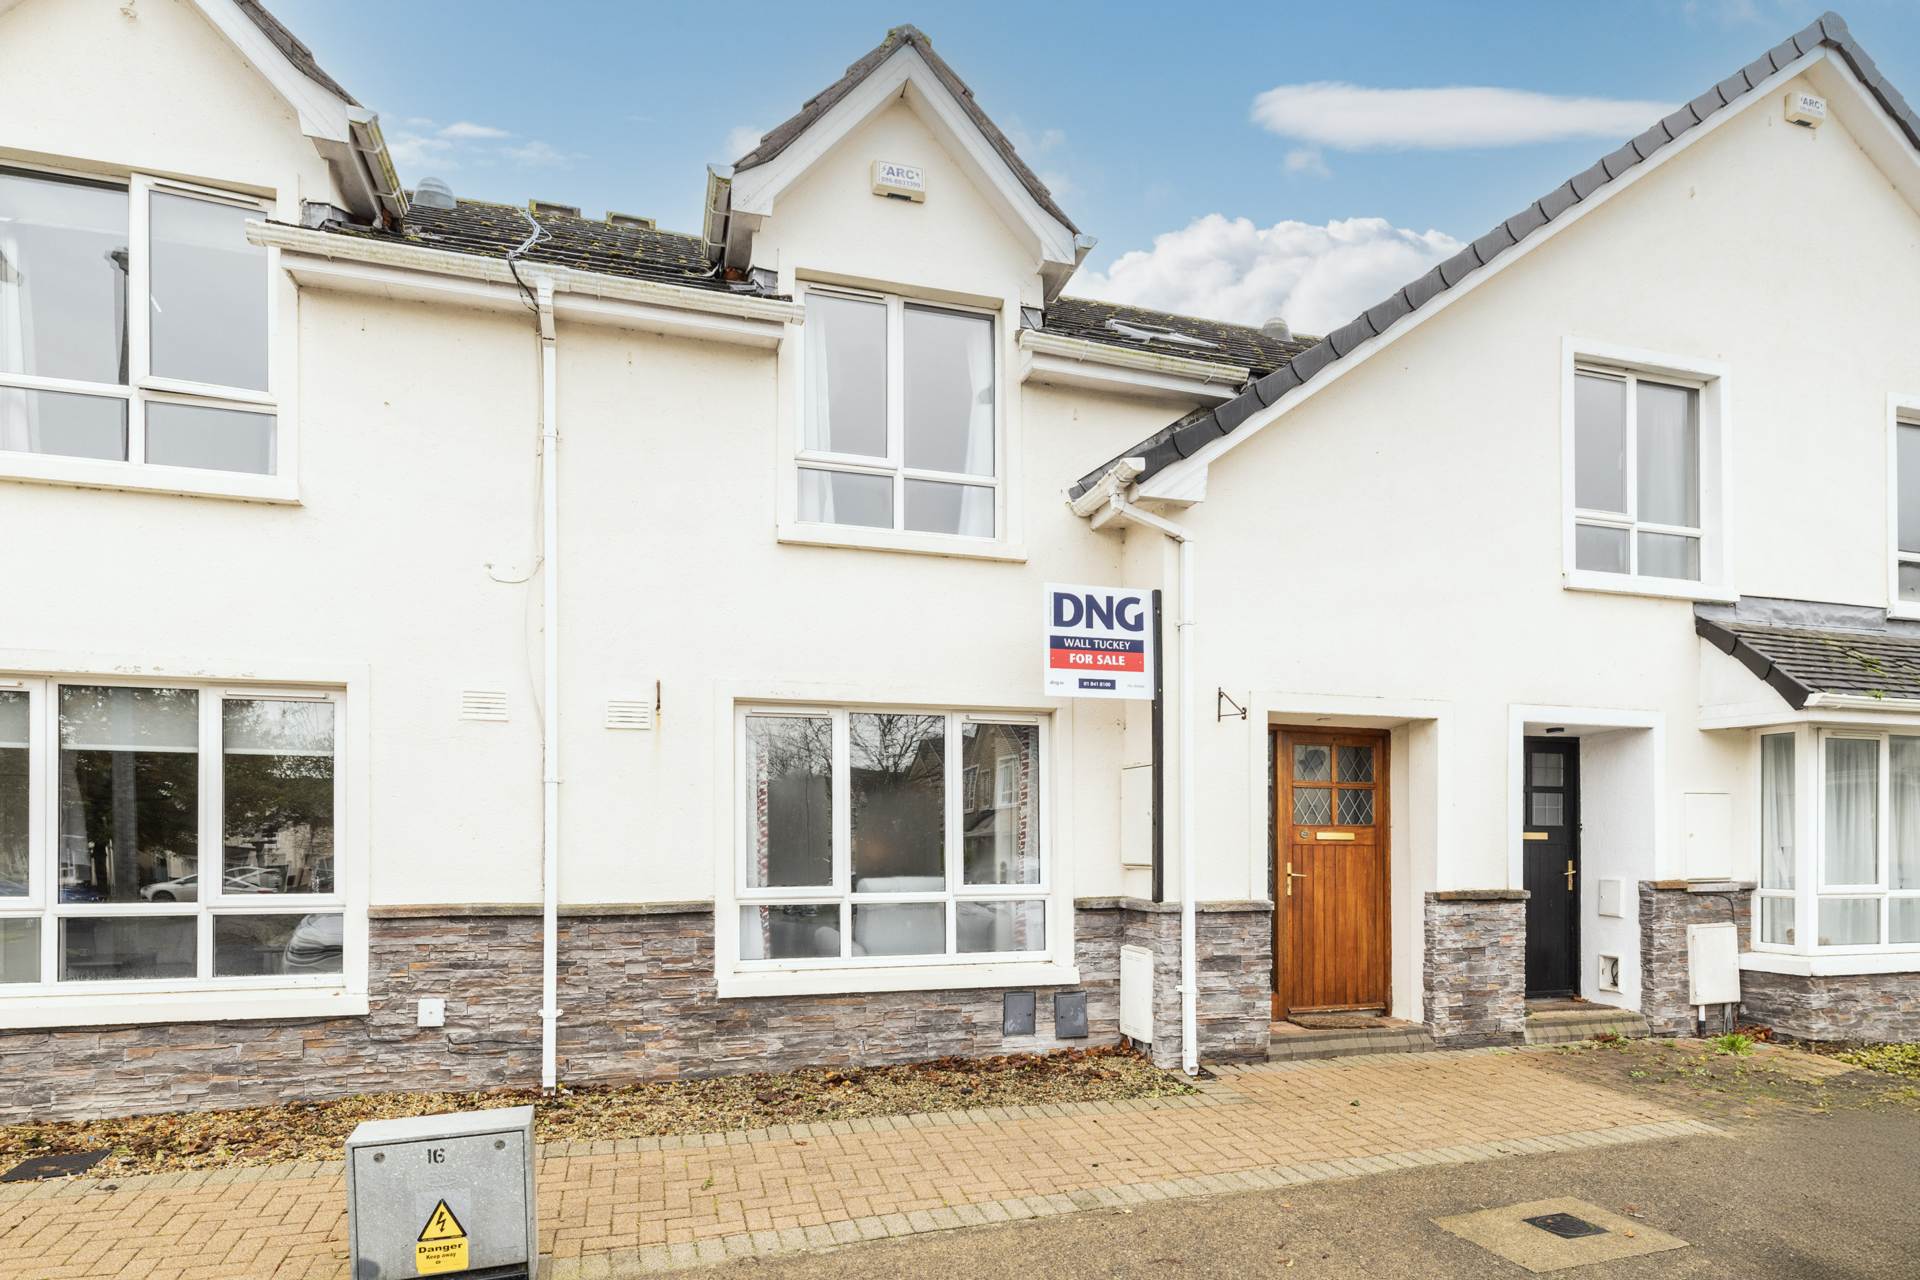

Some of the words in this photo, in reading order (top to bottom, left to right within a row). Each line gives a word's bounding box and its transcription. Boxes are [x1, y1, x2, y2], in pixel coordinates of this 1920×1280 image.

[1802, 97, 1821, 110] ARC
[886, 166, 915, 180] ARC
[1053, 592, 1144, 632] DNG
[1064, 638, 1091, 648] WALL
[1093, 640, 1131, 650] TUCKEY
[1069, 653, 1093, 664] FOR
[1097, 655, 1125, 666] SALE
[427, 1148, 445, 1164] 16
[418, 1243, 463, 1254] Danger
